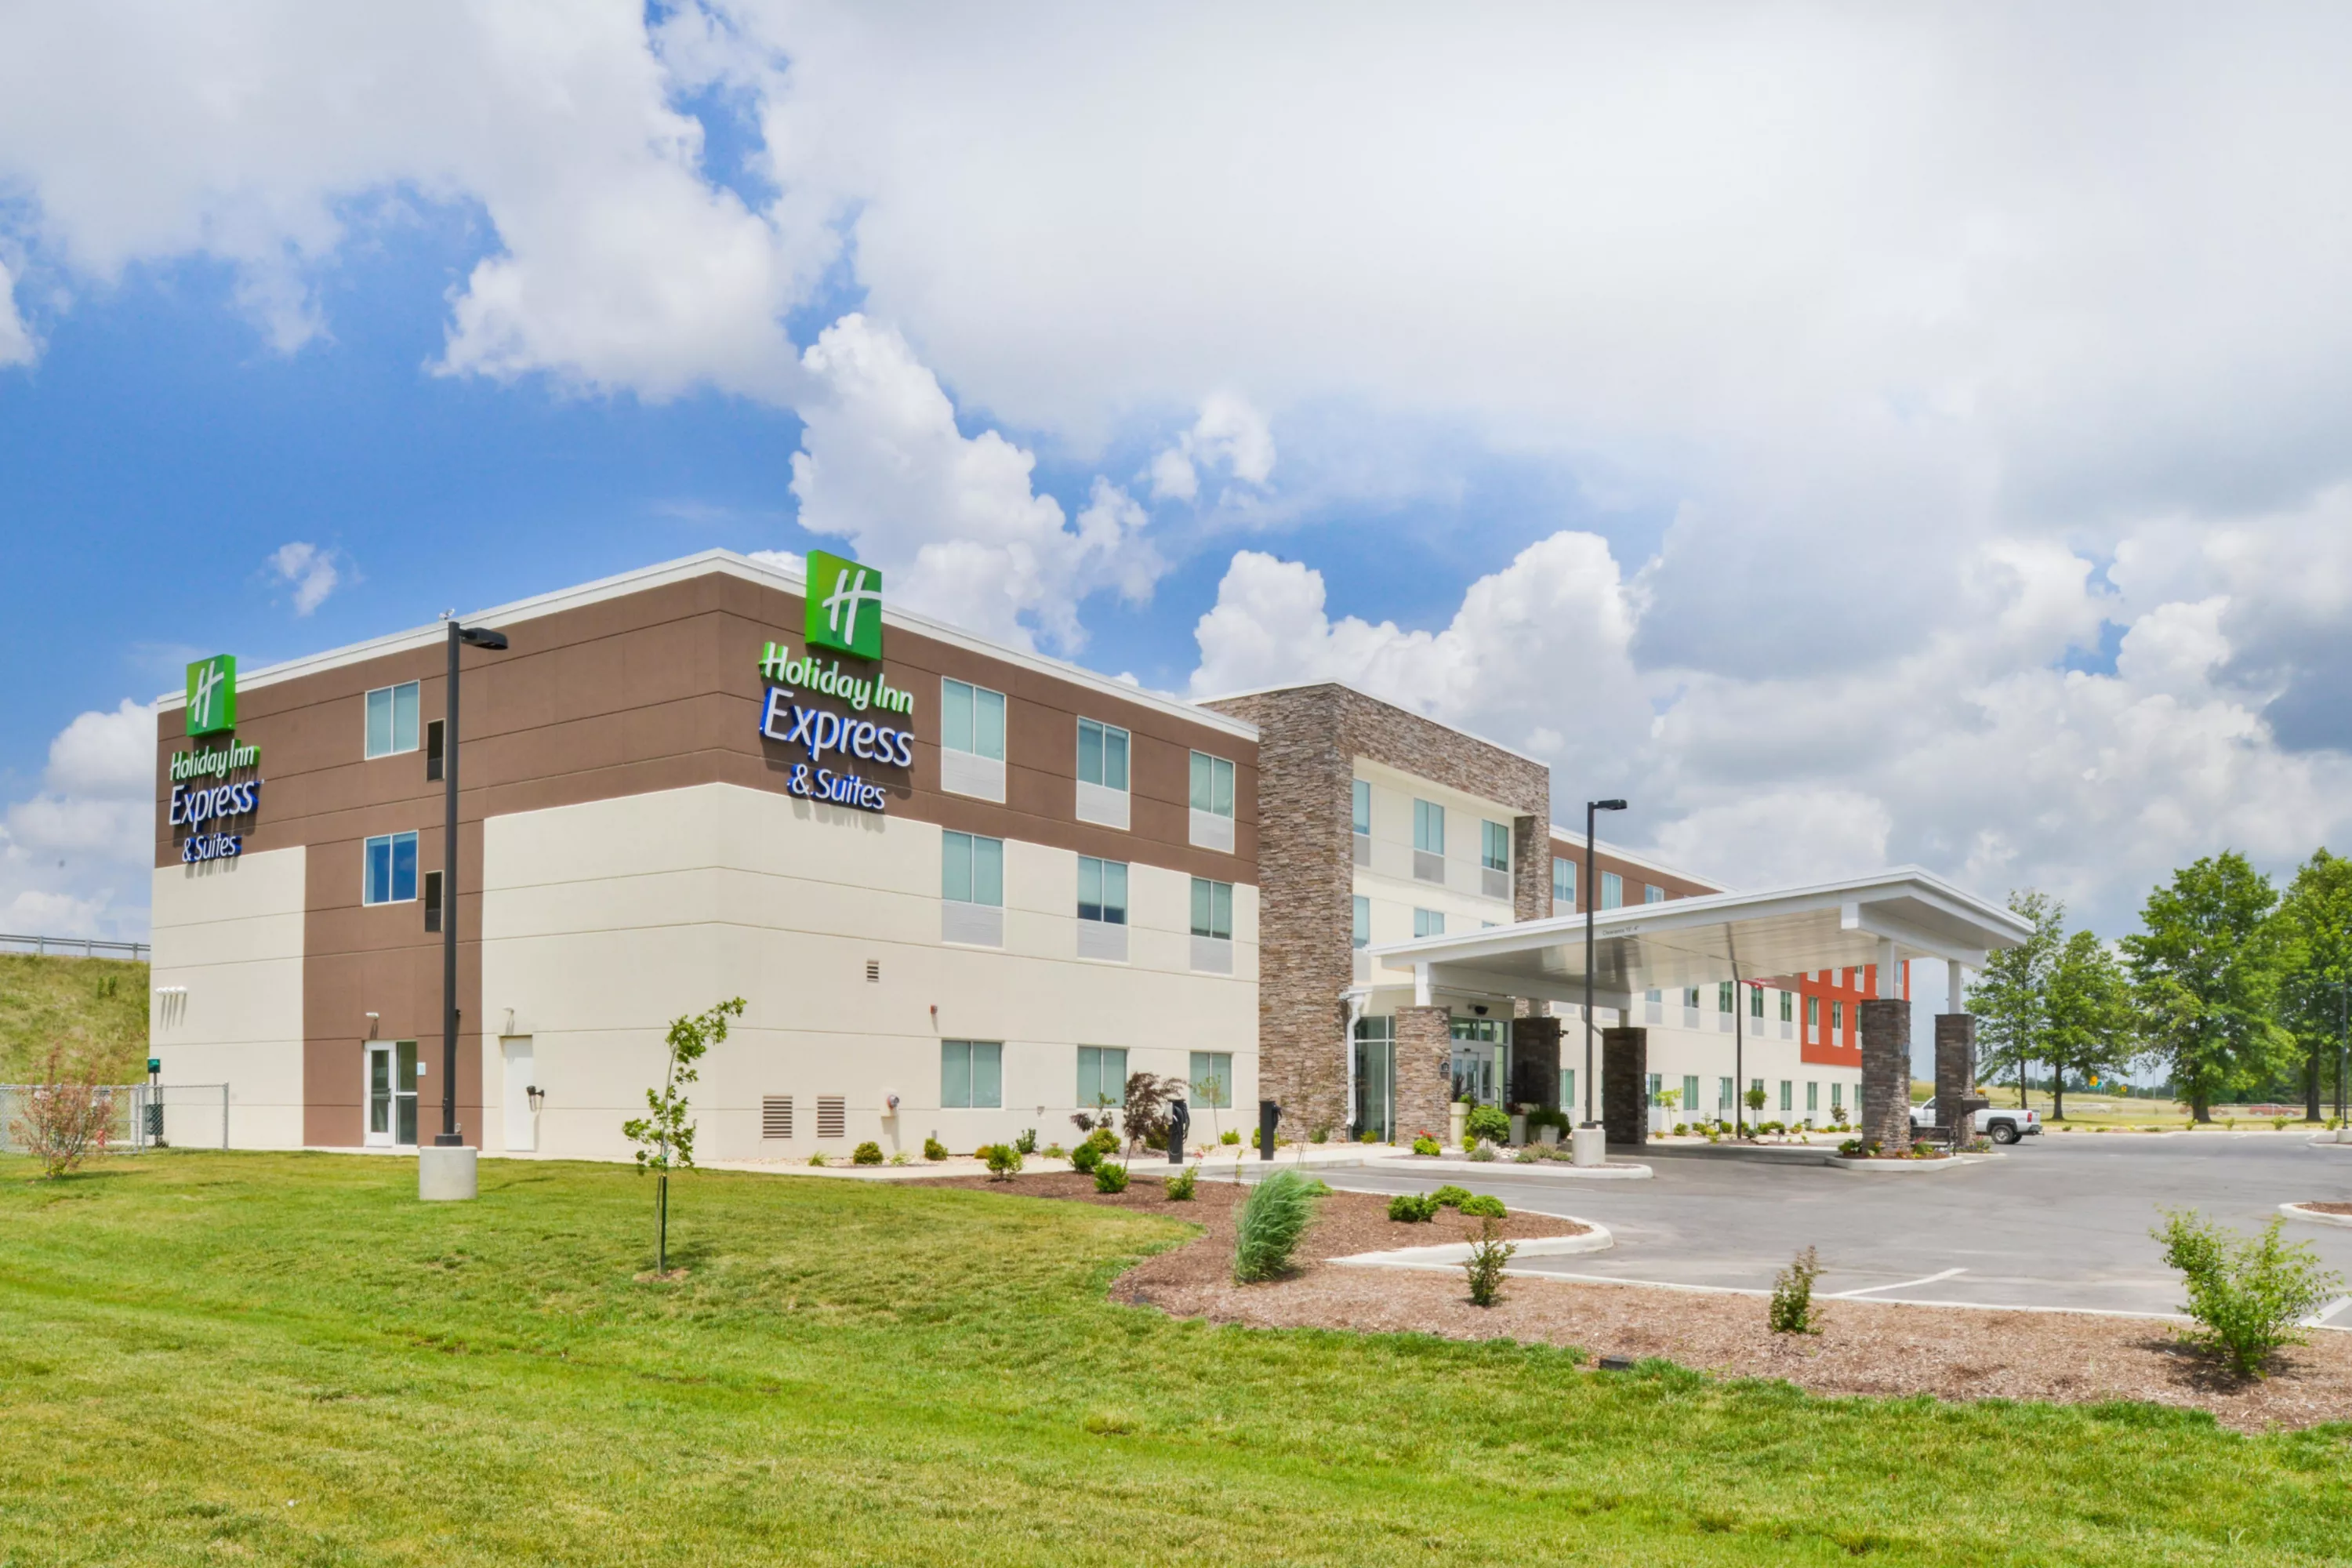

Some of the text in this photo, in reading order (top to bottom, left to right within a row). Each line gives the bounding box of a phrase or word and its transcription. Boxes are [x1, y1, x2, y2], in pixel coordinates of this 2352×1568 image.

[822, 569, 882, 645] H
[190, 660, 225, 728] H
[758, 641, 913, 714] Holiday Inn
[760, 686, 915, 767] Express
[169, 739, 259, 781] Holiday Inn
[788, 764, 886, 809] & Suites
[169, 780, 257, 833] Express
[182, 833, 240, 862] & Suites
